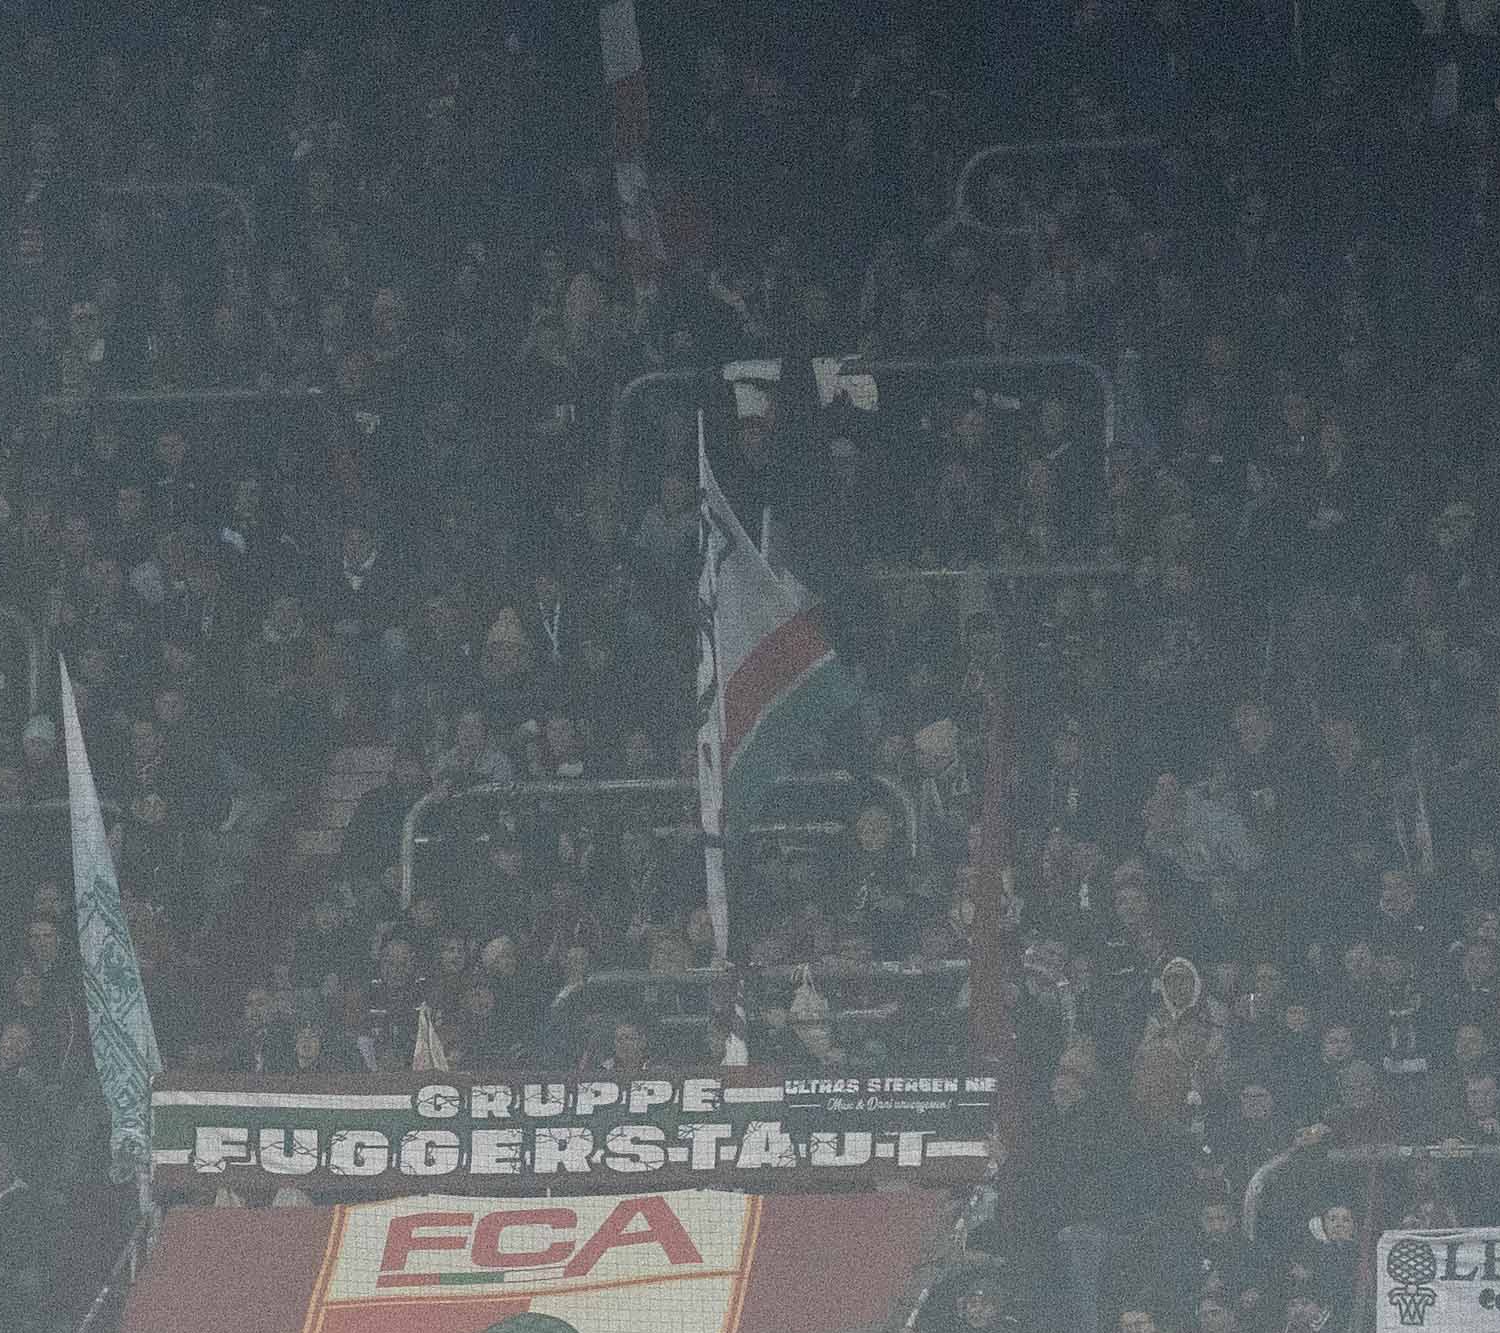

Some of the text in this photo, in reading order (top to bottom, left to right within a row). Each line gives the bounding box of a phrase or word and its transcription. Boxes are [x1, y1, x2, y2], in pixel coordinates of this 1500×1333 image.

[416, 1078, 721, 1118] GRUPPE
[784, 1079, 859, 1093] ULTRAS
[377, 1196, 705, 1274] FCA
